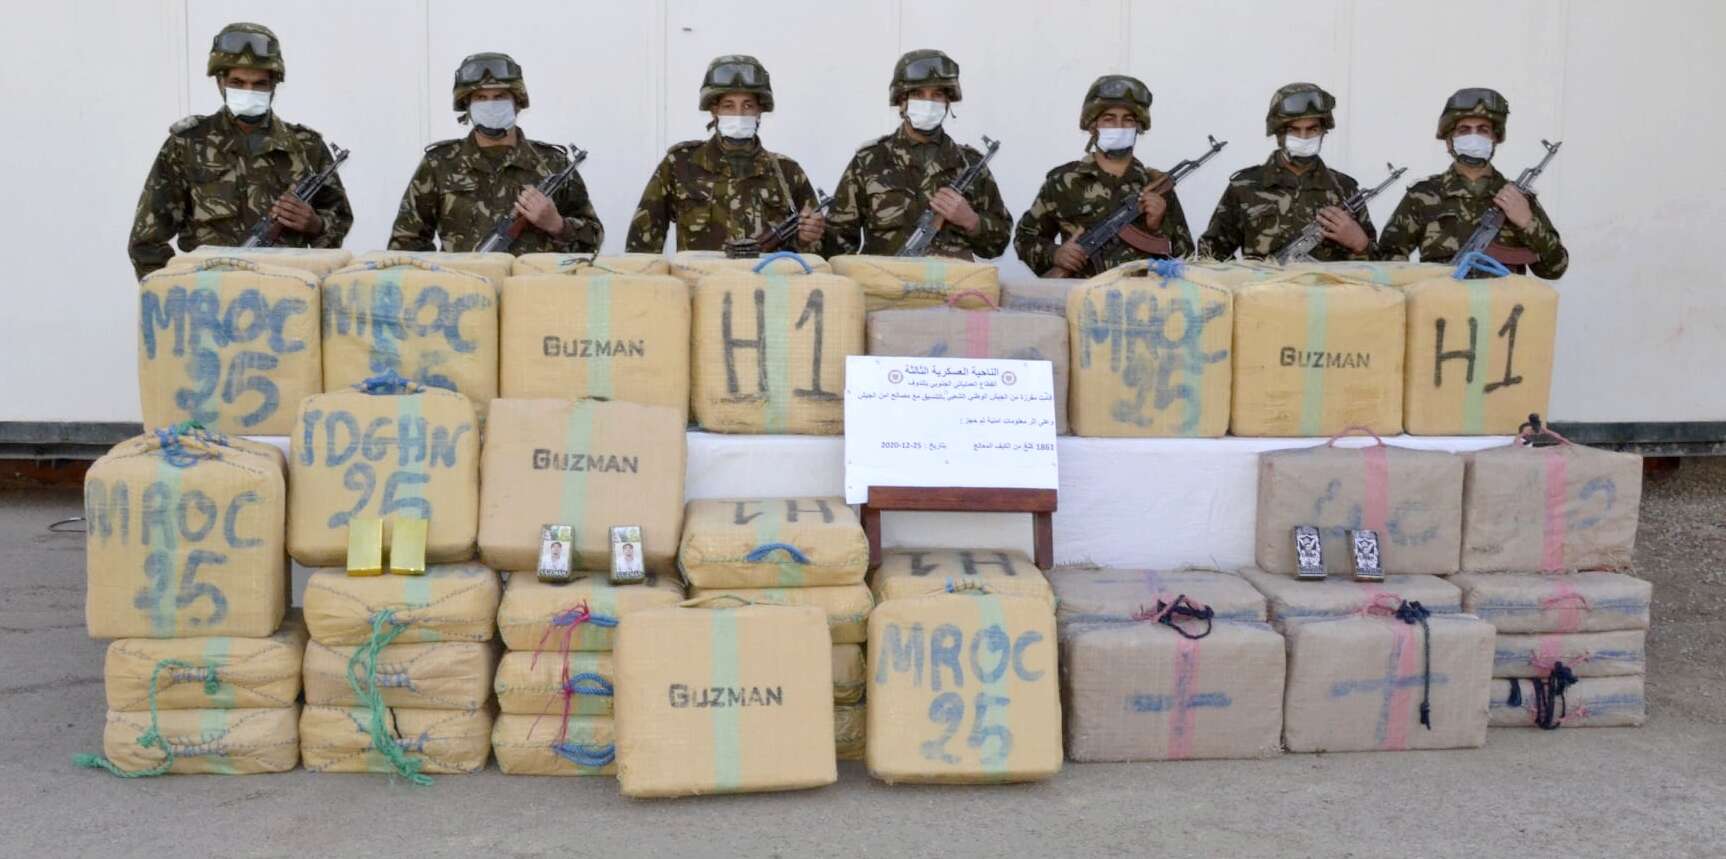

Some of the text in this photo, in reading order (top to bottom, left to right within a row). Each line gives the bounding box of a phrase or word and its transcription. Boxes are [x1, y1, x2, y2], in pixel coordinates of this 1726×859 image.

[543, 336, 645, 358] GUZMAN
[1280, 346, 1370, 369] GUZMAN
[905, 364, 929, 375] الثالثة
[932, 365, 969, 378] العسكرية
[176, 348, 279, 427] 25
[532, 447, 639, 473] GUZMAN
[134, 550, 229, 627] 25
[669, 683, 784, 708] GUZMAN
[919, 691, 1013, 765] 25
